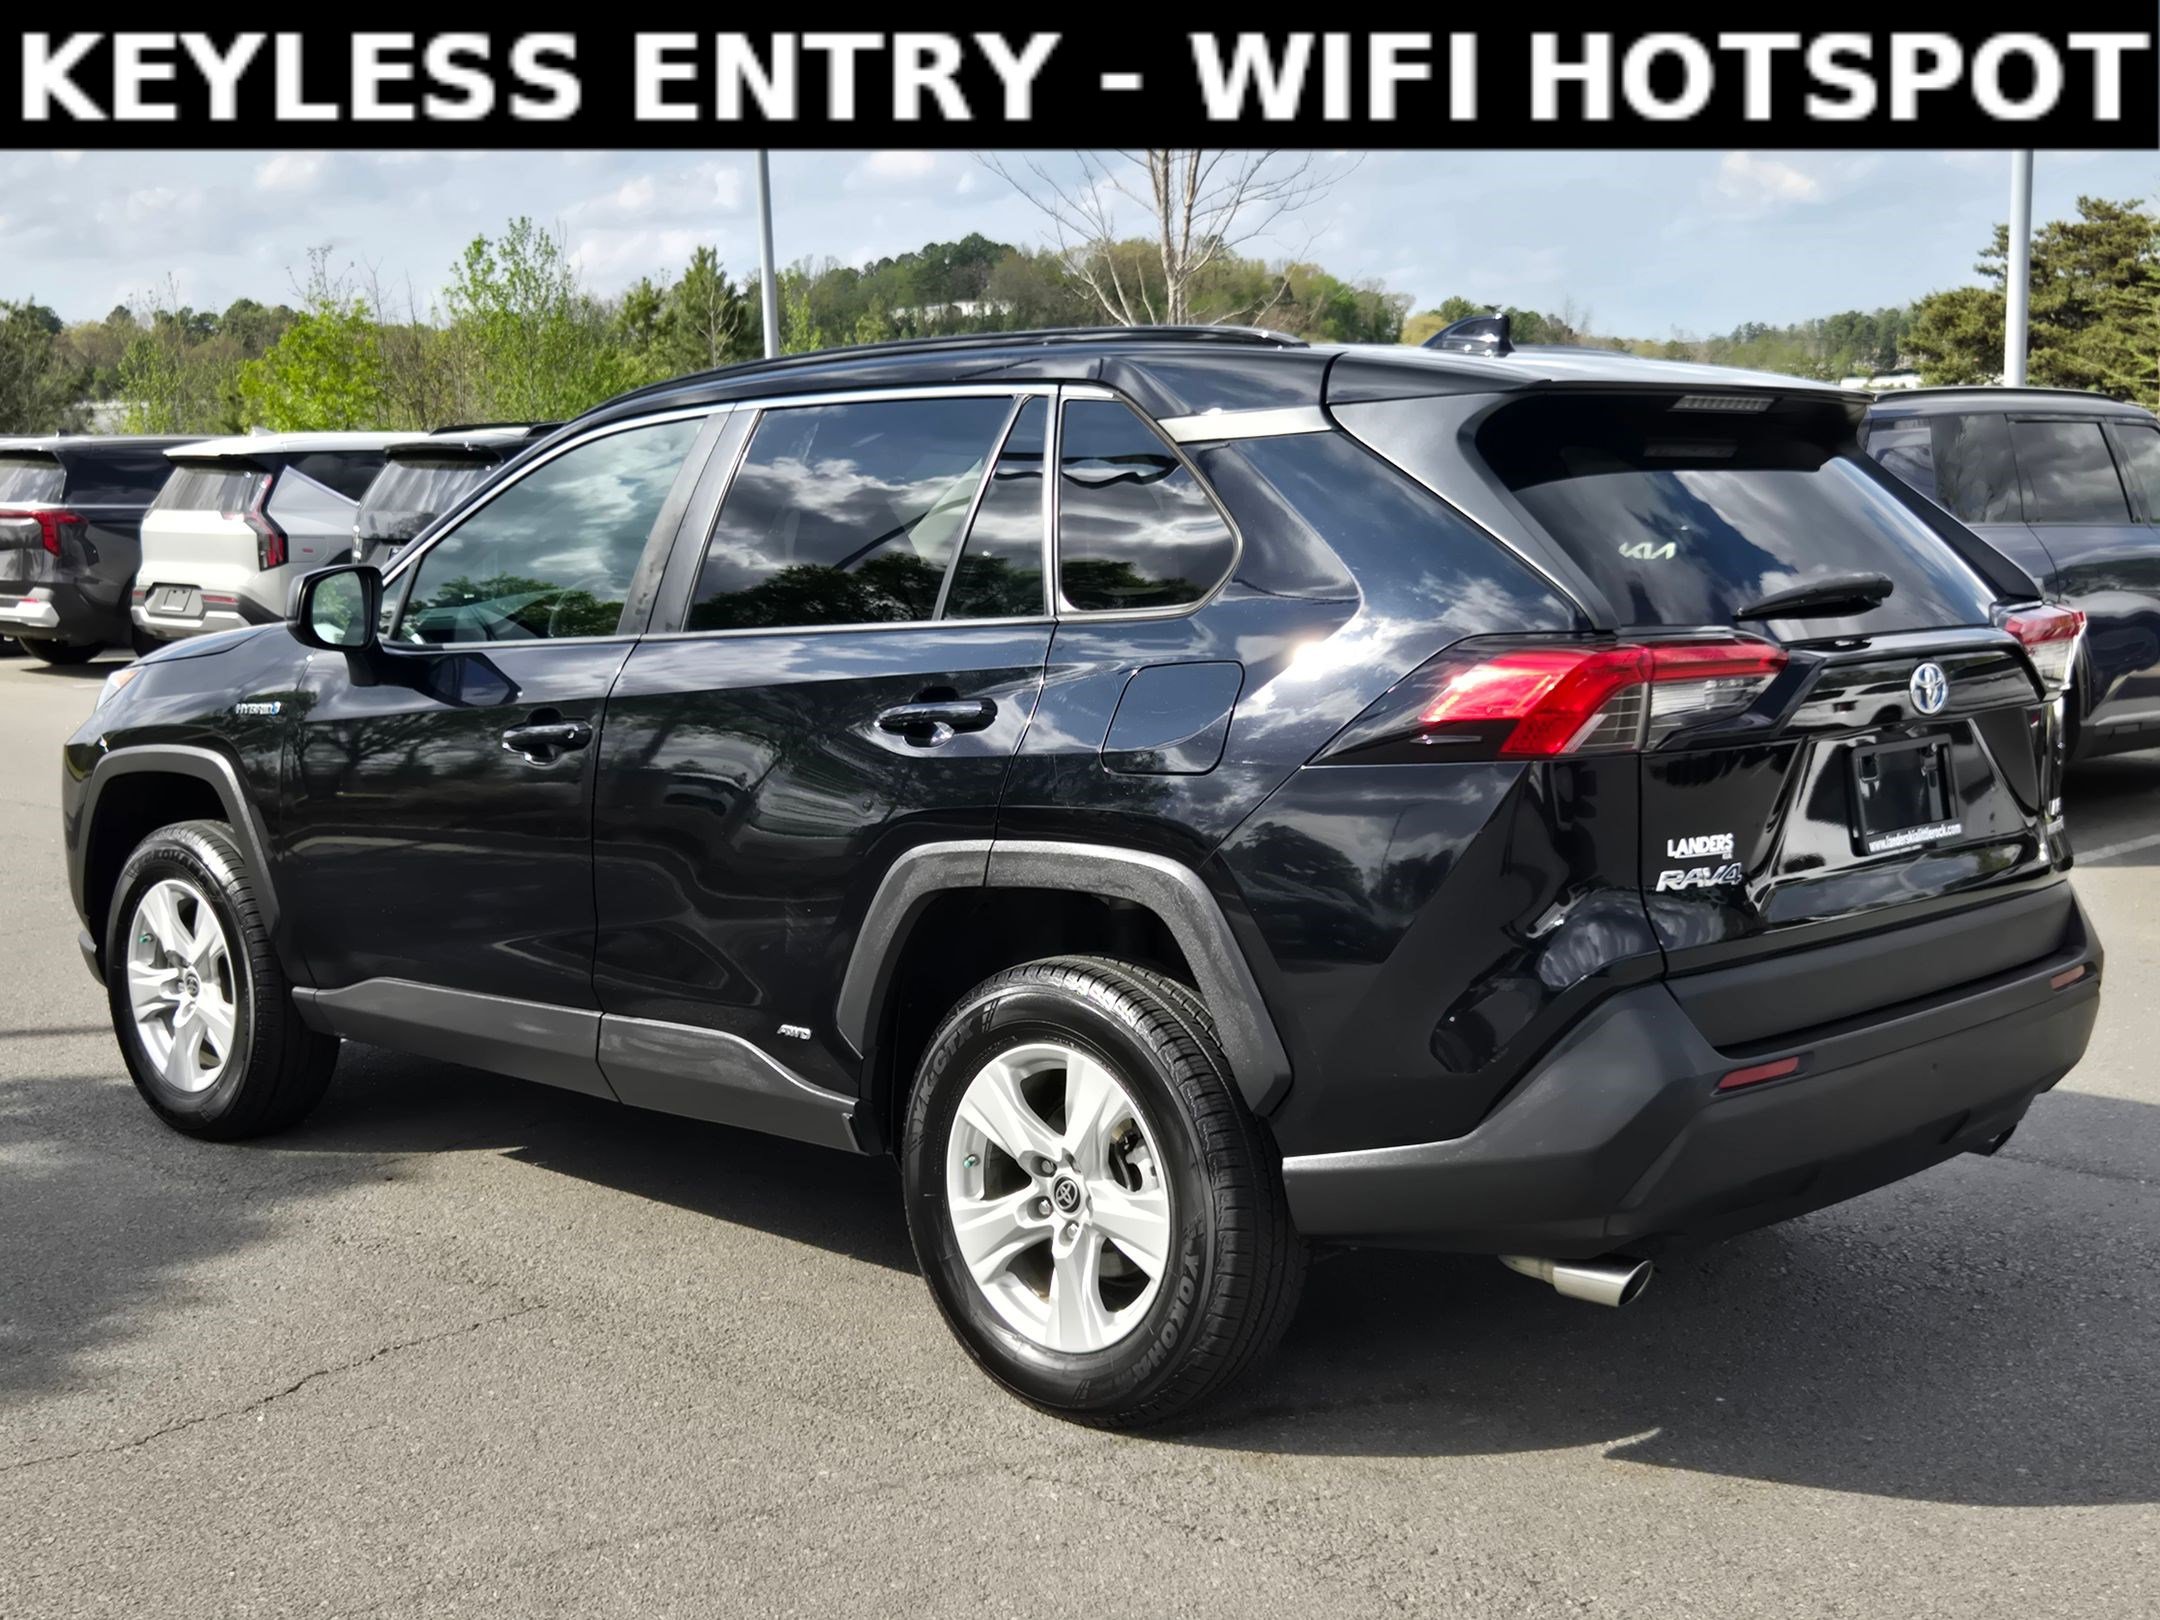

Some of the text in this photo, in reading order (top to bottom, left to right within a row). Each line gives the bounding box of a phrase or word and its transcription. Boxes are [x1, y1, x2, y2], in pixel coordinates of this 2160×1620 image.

[1617, 542, 1677, 561] KIA
[235, 702, 274, 715] HYBRID
[1666, 832, 1734, 858] LANDERS
[1655, 862, 1743, 892] RAV4
